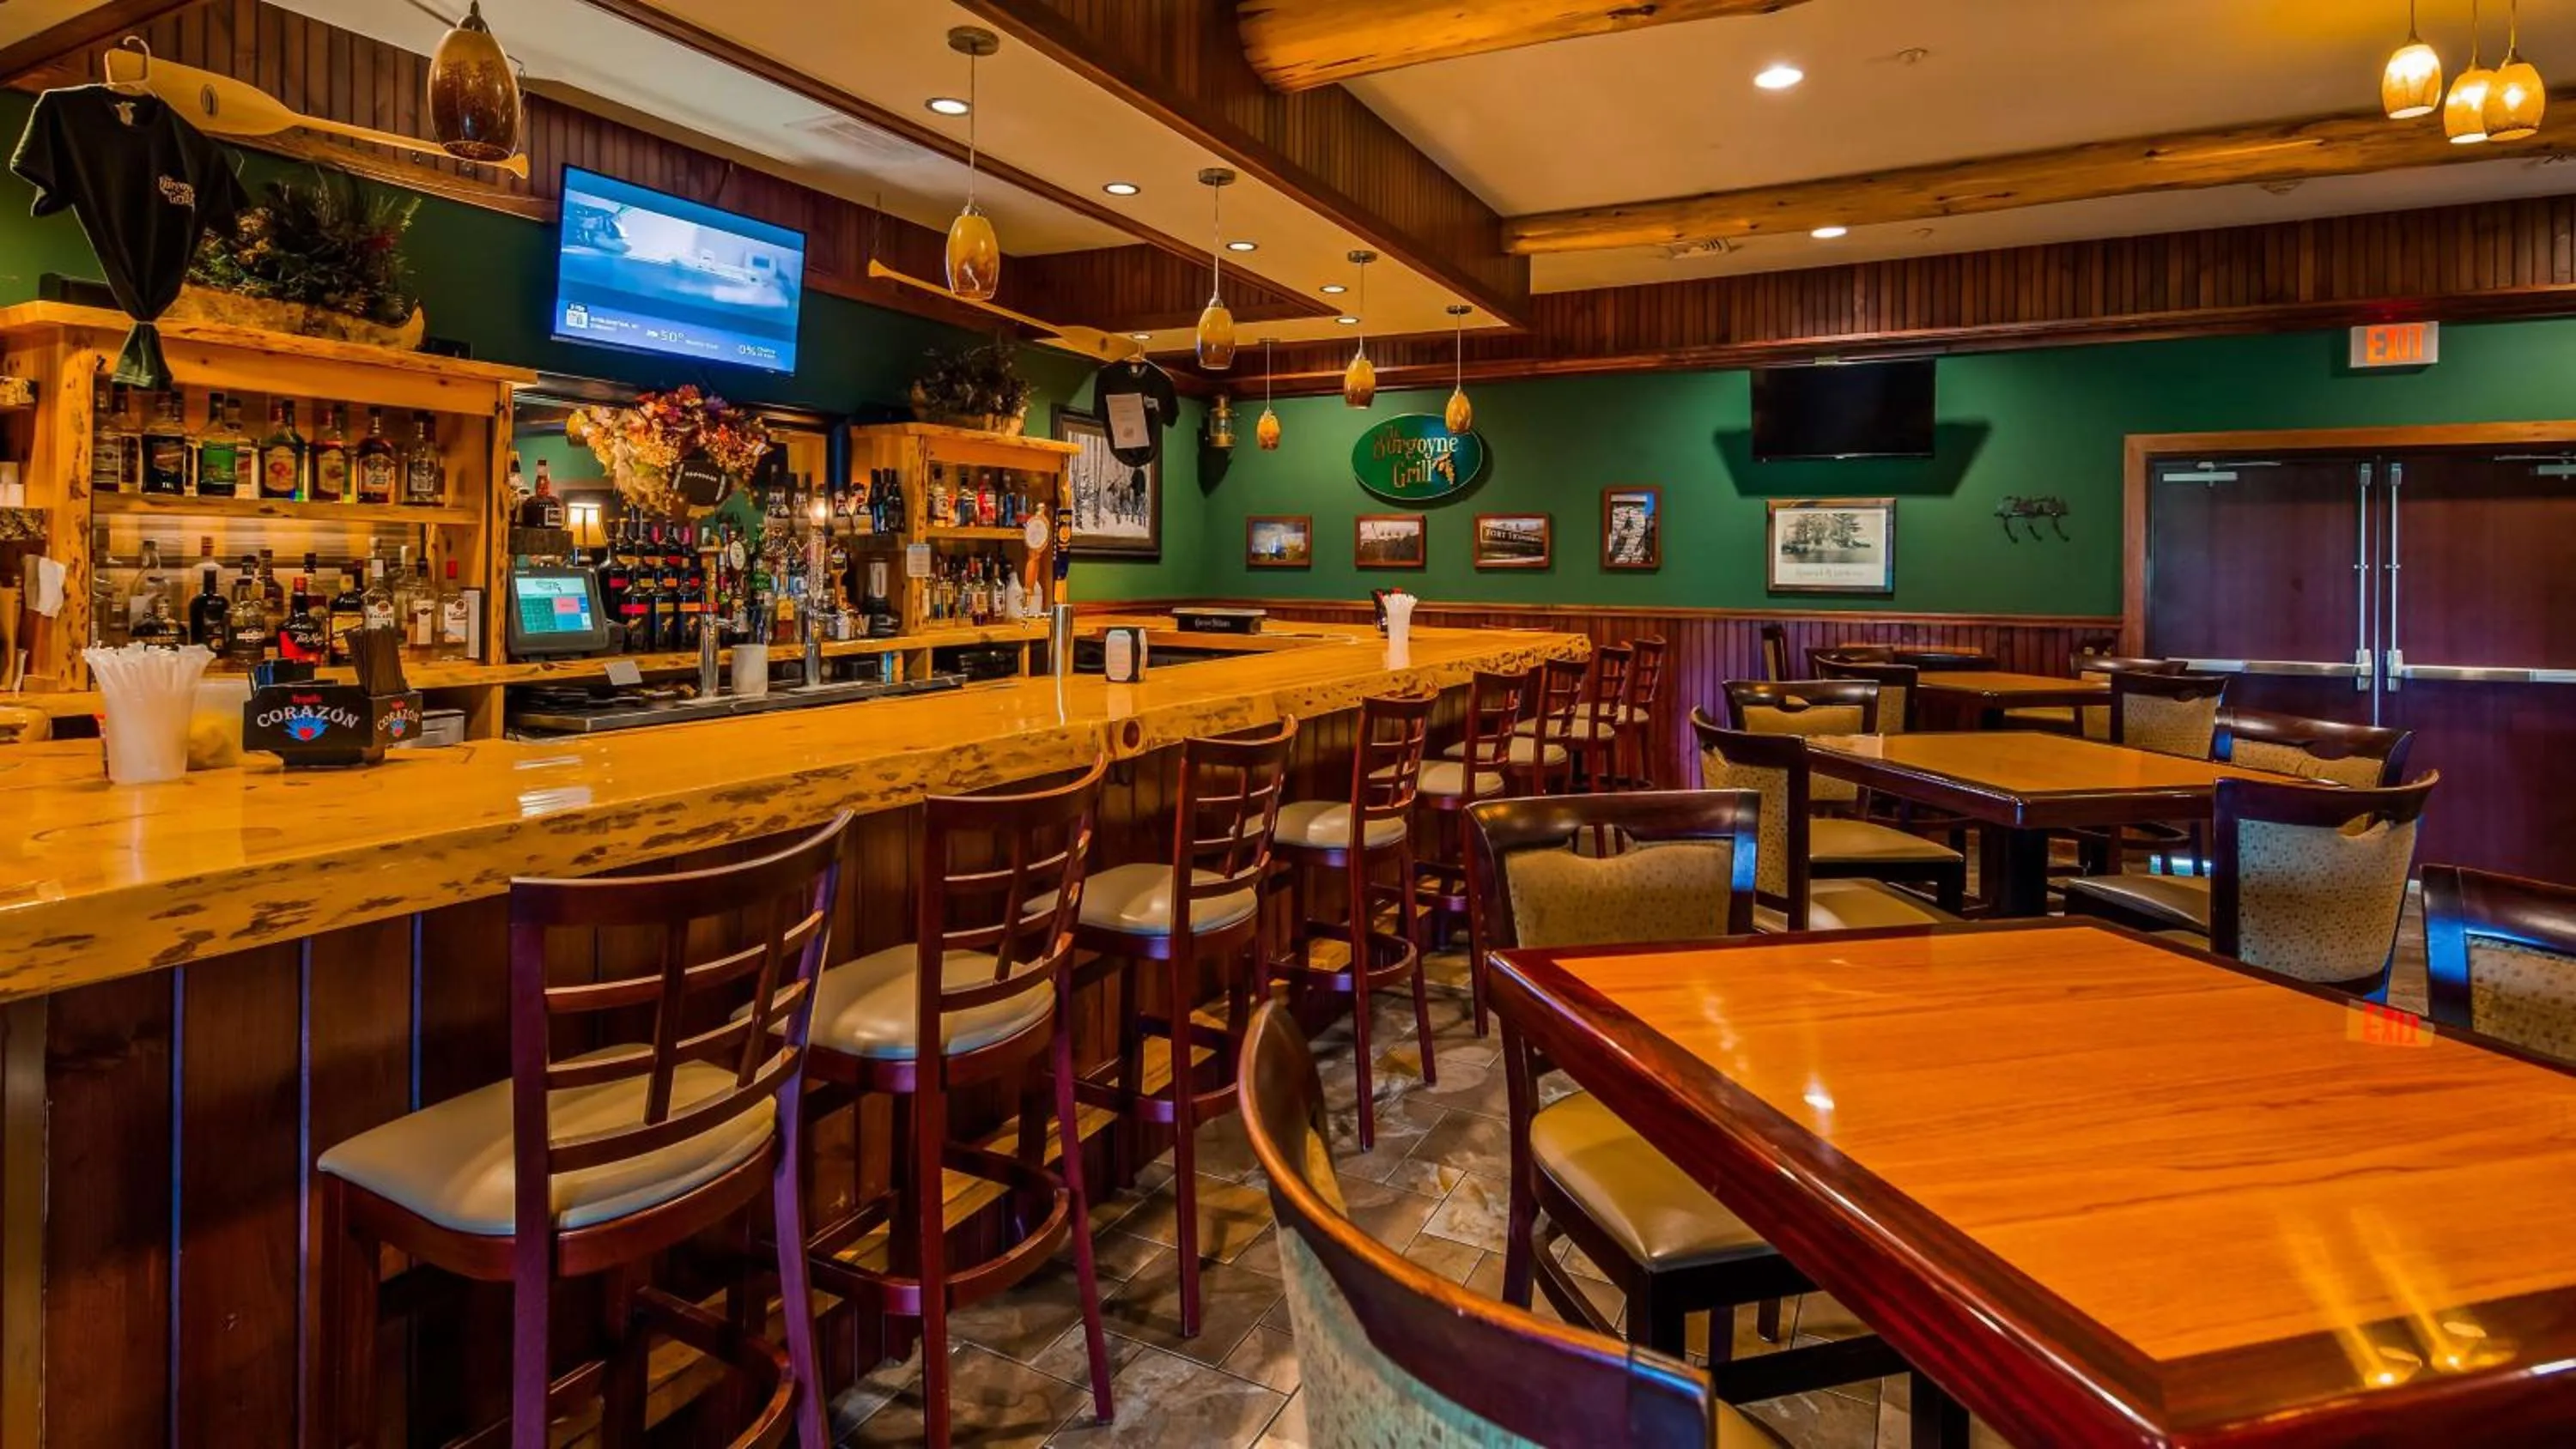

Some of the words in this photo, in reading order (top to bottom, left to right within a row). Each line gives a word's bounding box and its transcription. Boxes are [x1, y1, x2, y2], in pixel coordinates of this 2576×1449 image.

[2366, 324, 2424, 364] EXIT
[1393, 458, 1432, 488] Grill
[257, 705, 360, 728] CORAZÓN
